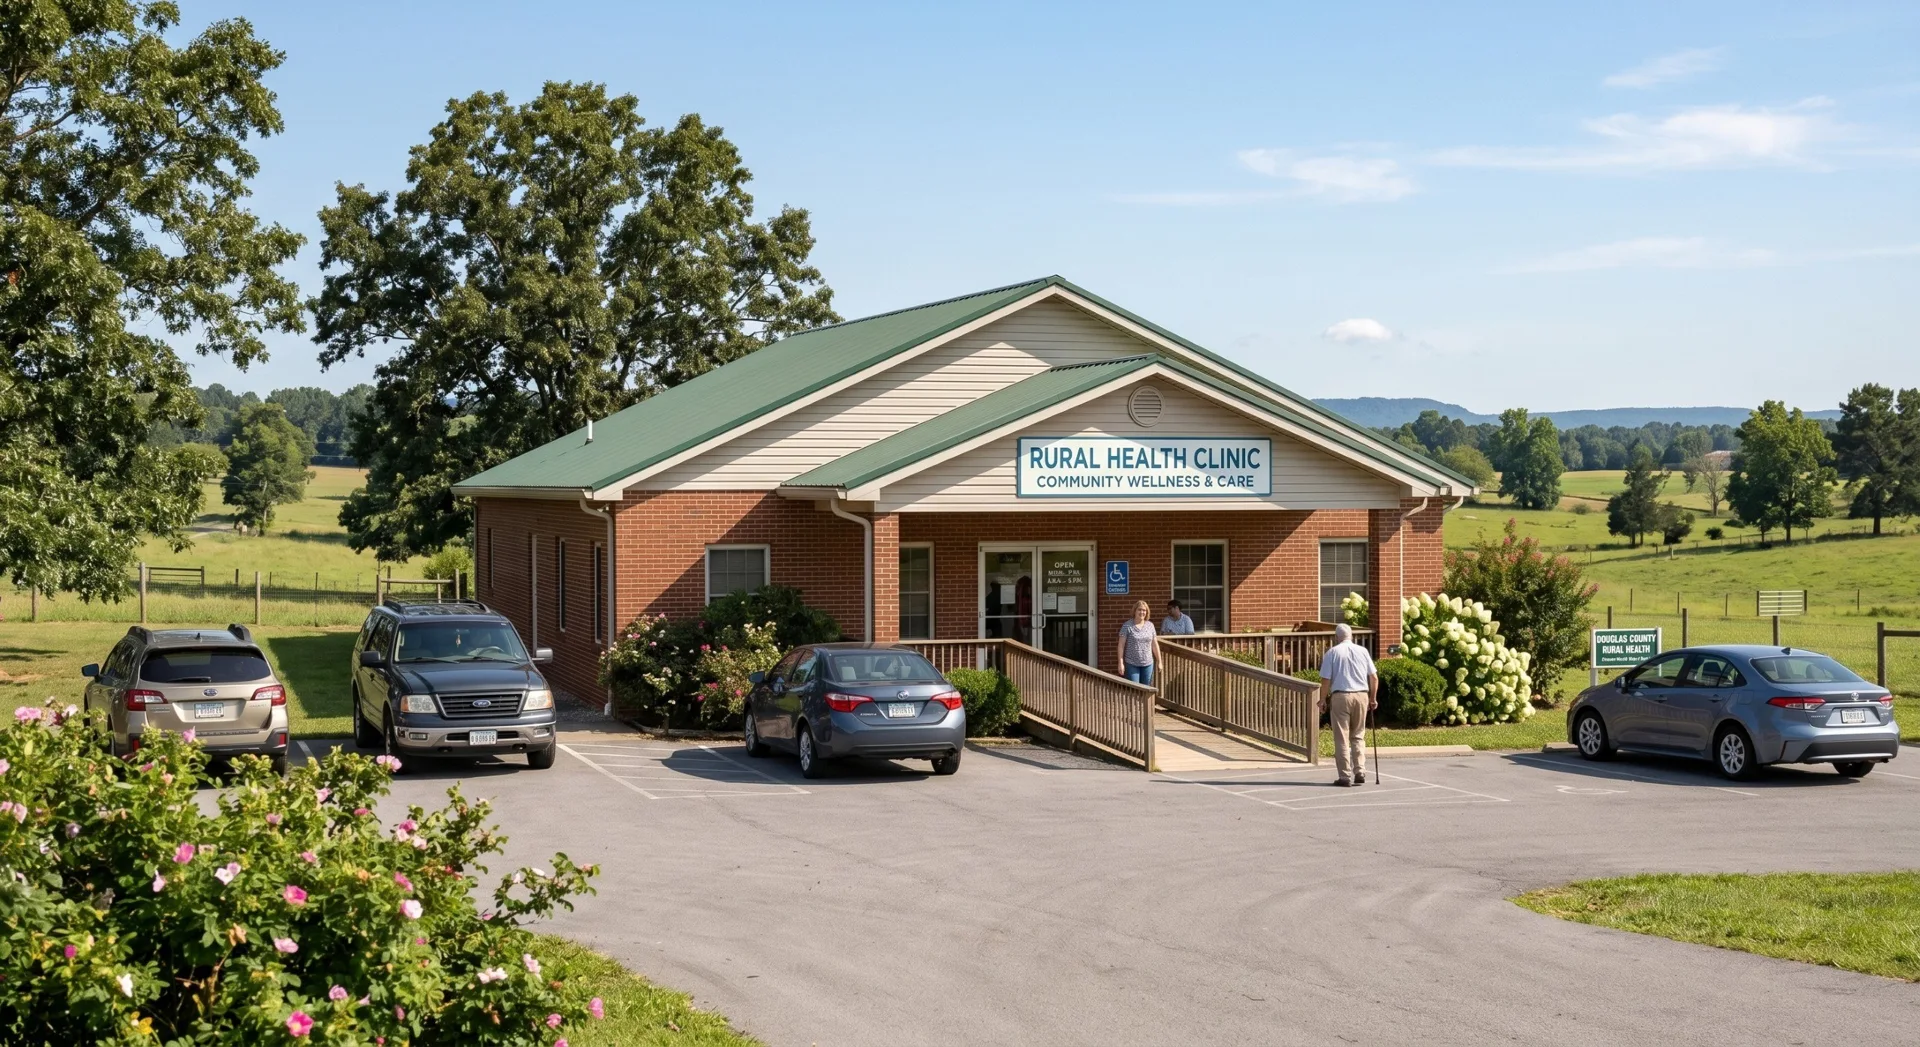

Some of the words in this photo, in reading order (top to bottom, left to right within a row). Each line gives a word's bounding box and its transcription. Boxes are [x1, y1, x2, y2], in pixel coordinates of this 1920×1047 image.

[1030, 447, 1100, 469] RURAL
[1107, 447, 1187, 469] HEALTH
[1193, 447, 1261, 469] CLINIC
[1036, 475, 1123, 488] COMMUNITY
[1127, 475, 1200, 488] WELLNESS
[1204, 475, 1213, 488] &
[1217, 475, 1254, 488] CARE
[1054, 561, 1075, 569] OPEN
[1596, 634, 1628, 644] DOUGLAS
[1629, 633, 1657, 643] COUNTY
[1602, 645, 1624, 654] RURAL
[1625, 644, 1651, 654] HEALTH
